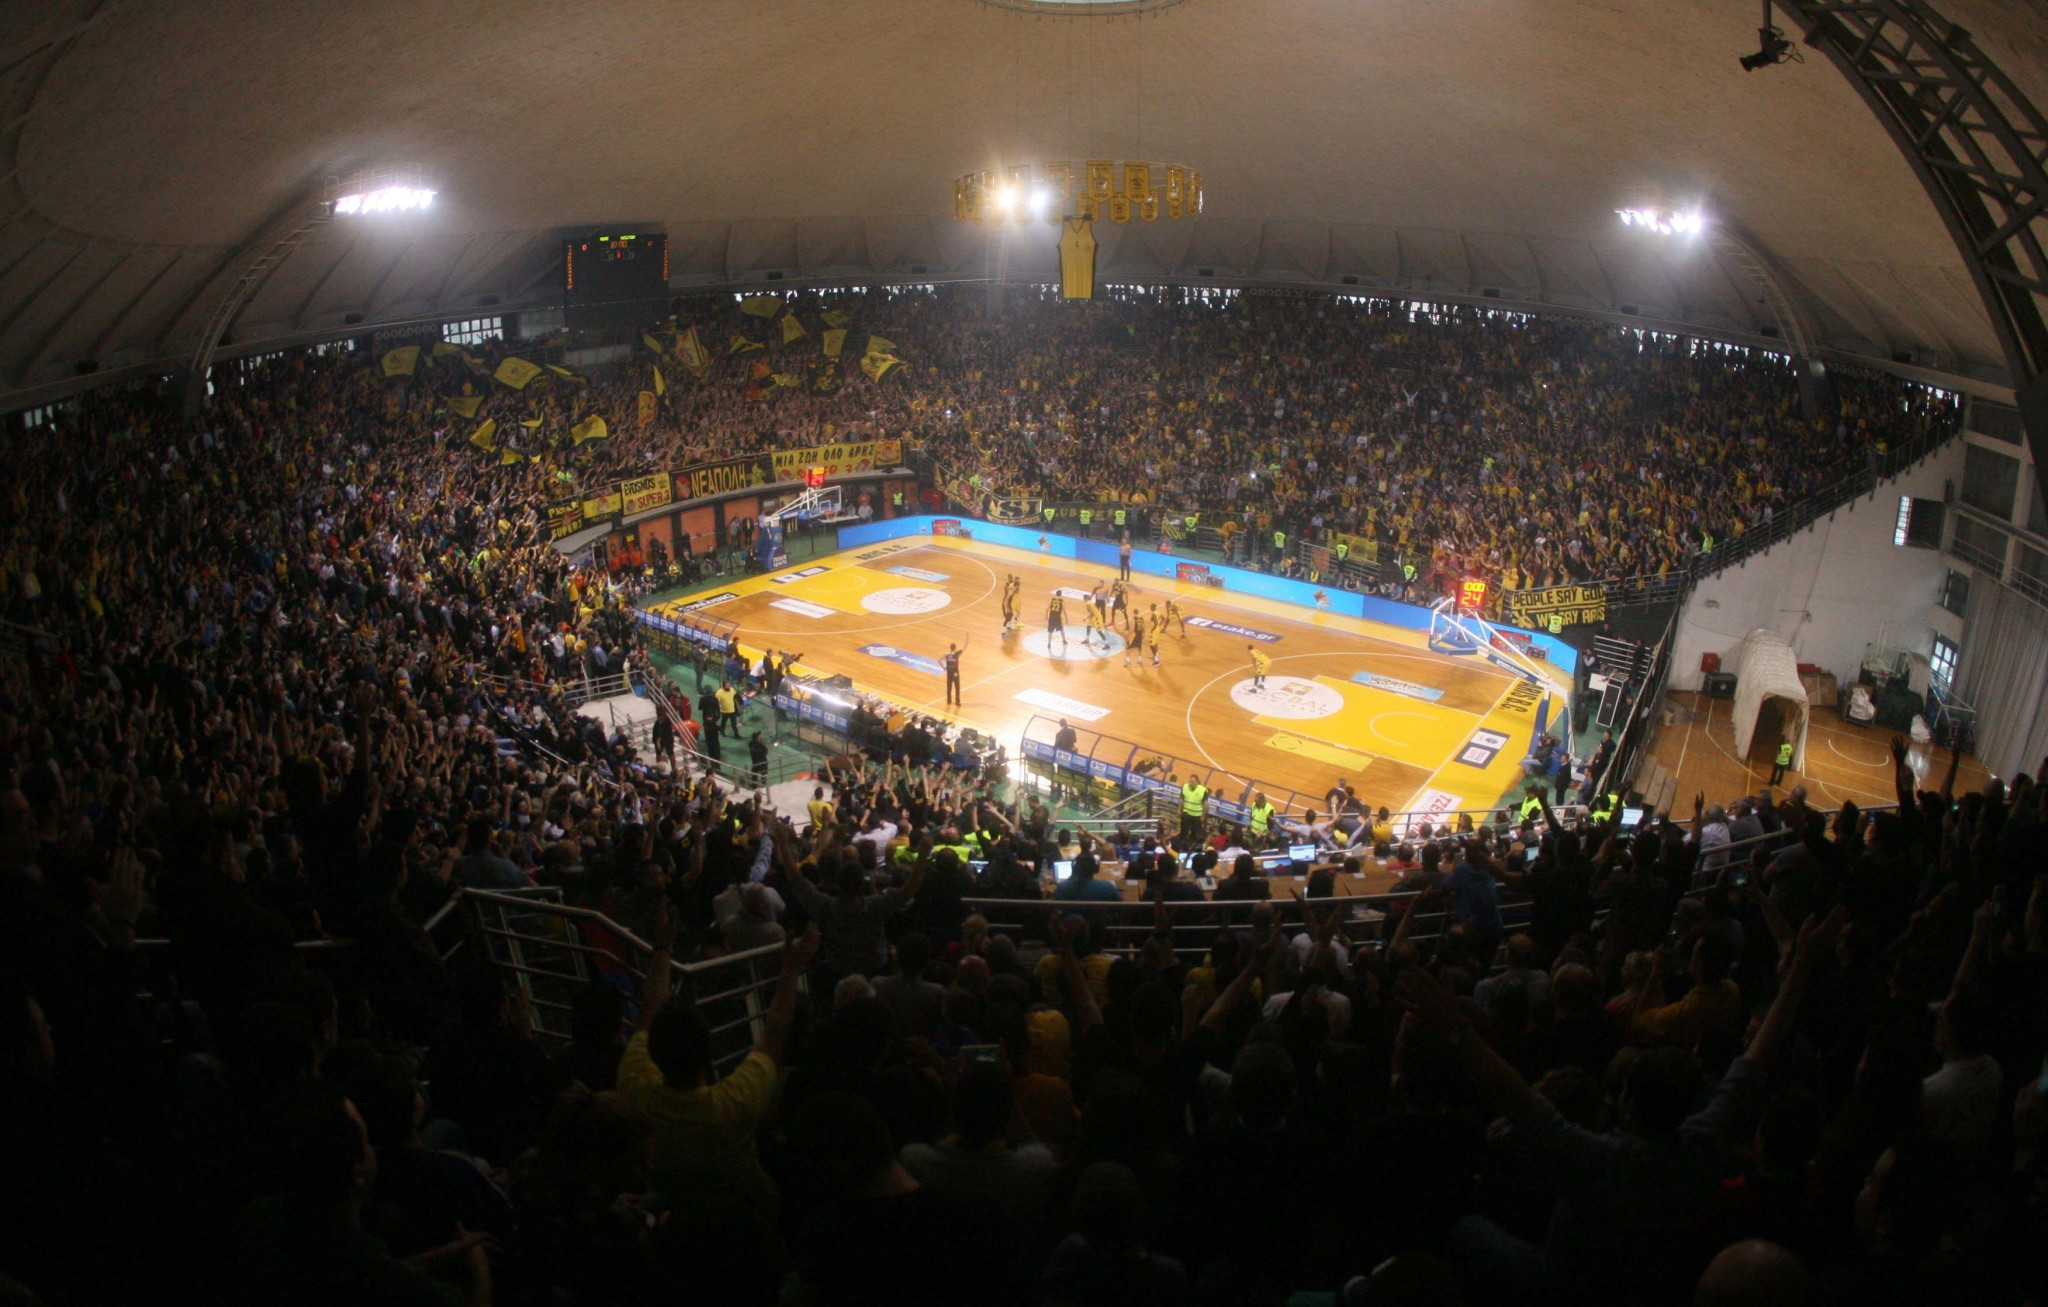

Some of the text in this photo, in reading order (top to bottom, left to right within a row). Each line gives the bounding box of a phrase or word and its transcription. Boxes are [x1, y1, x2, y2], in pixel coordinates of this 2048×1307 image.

[775, 444, 875, 467] ΜΙΑ ΖΩΗ ΟΛΟ ΑΡΗΣ
[691, 463, 746, 497] ΝΕΑΠΟΛΗ
[637, 489, 670, 509] SUPER 3
[1461, 592, 1482, 606] 24
[1513, 590, 1554, 606] PEOPLE
[1557, 587, 1577, 603] SAY
[1051, 603, 1060, 612] 22
[1582, 607, 1605, 624] ARIS
[1211, 622, 1276, 641] esake.gr
